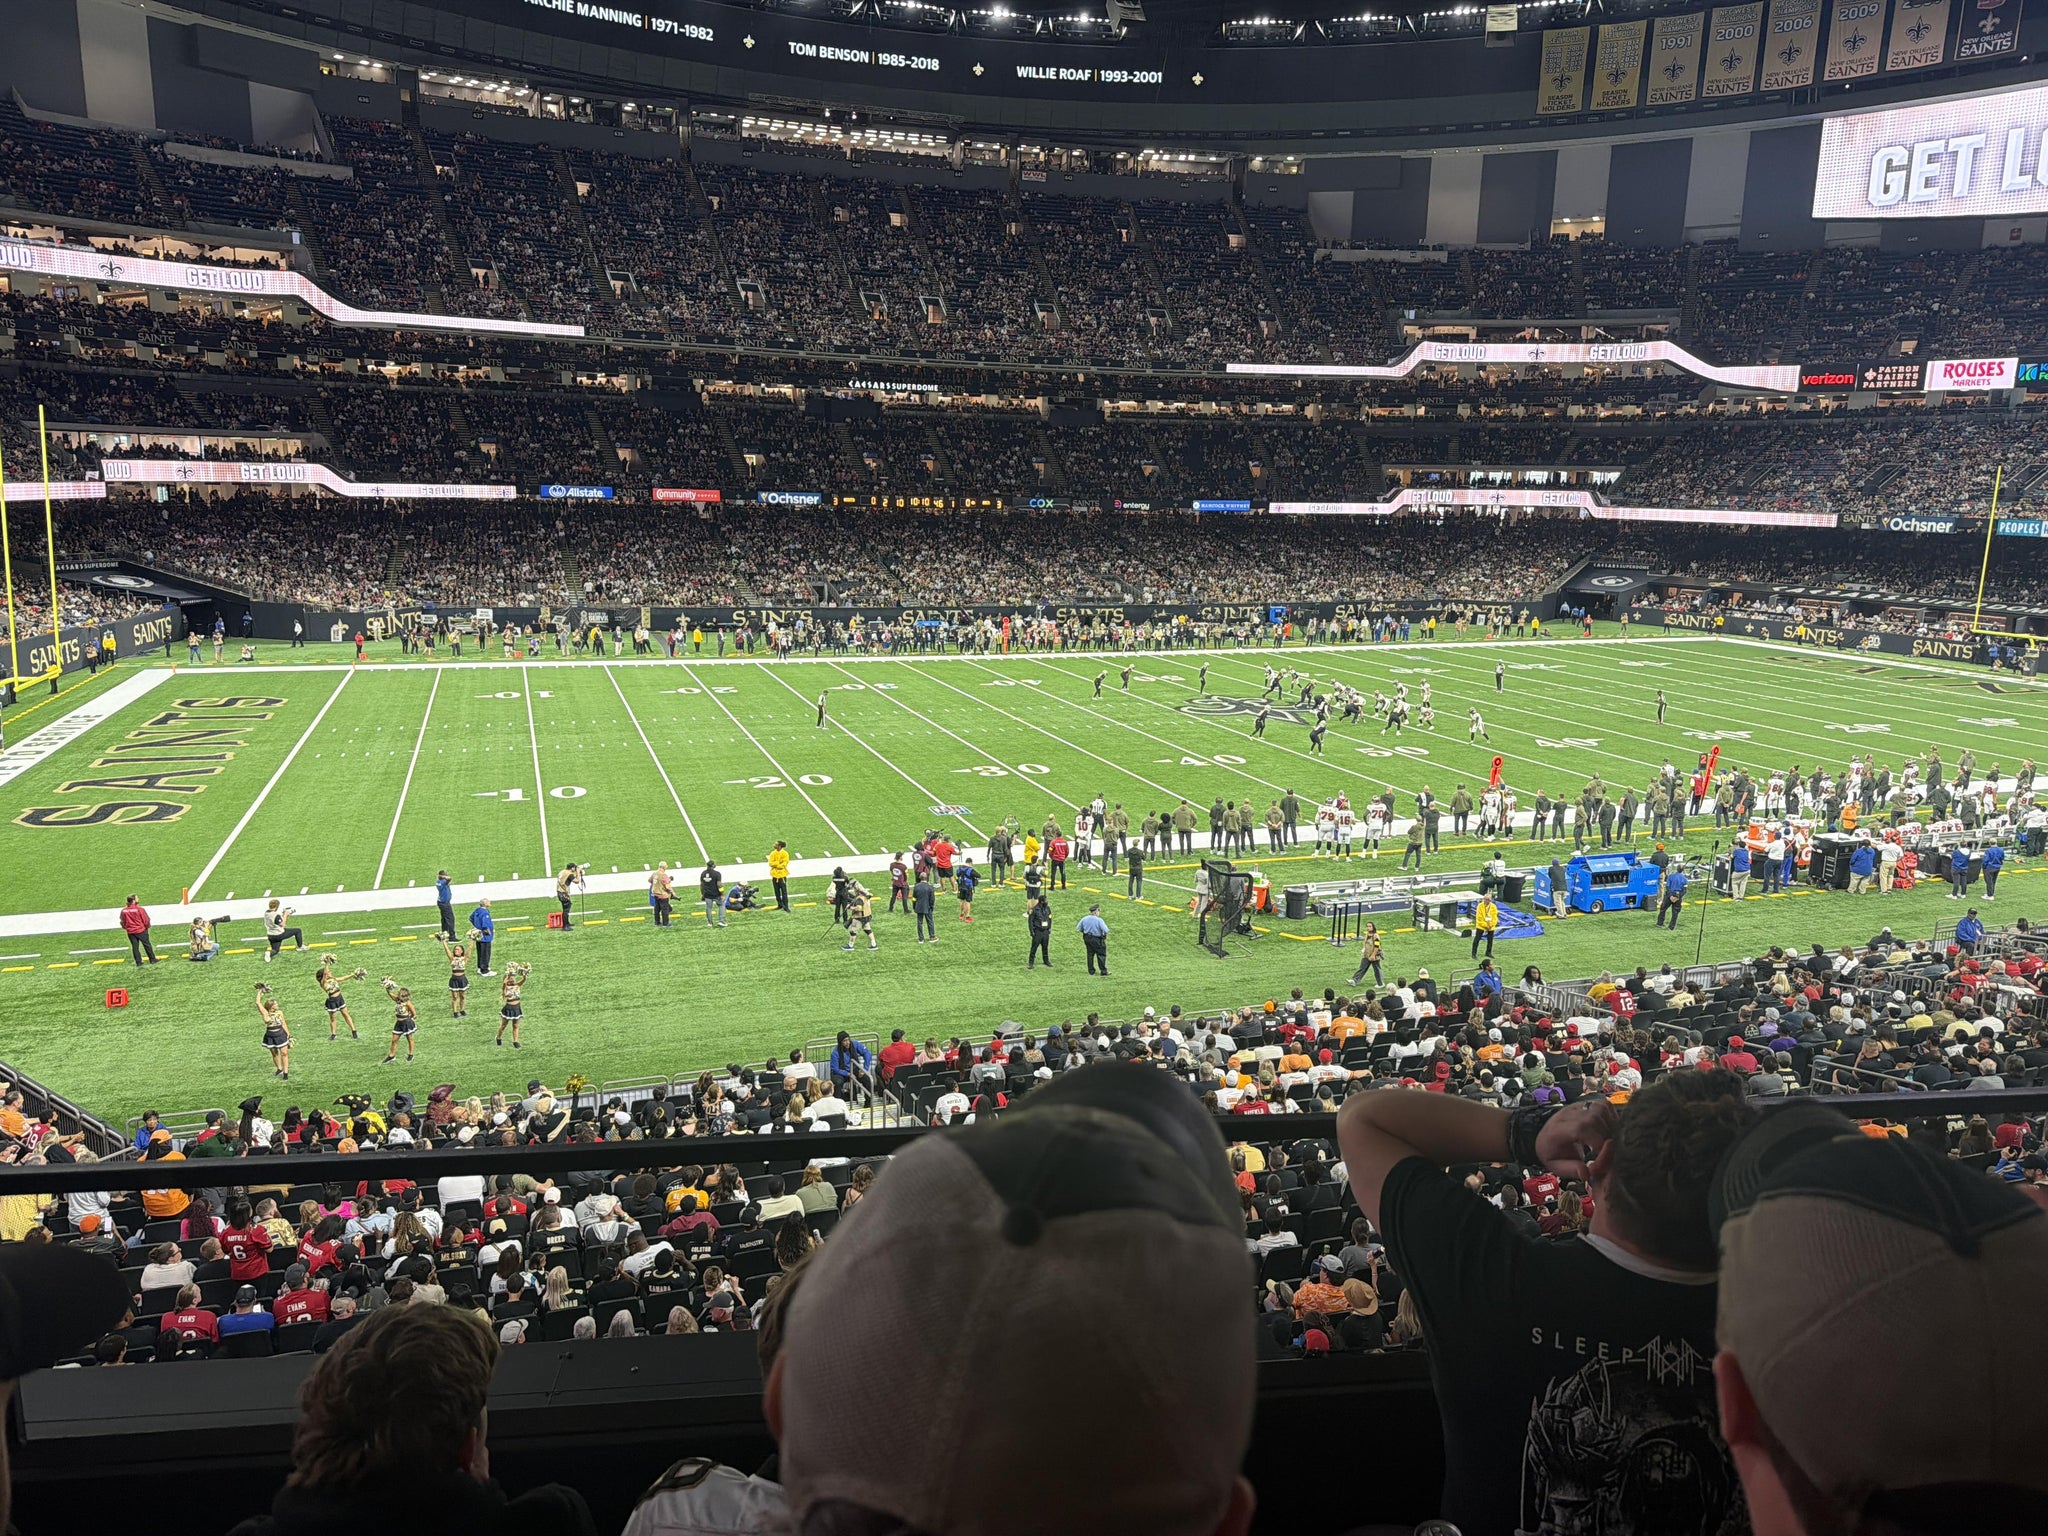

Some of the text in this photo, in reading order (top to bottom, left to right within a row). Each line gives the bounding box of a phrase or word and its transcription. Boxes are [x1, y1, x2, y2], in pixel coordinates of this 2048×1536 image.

[1838, 3, 1879, 21] 2009
[525, 0, 714, 41] CHIE MANNING 1971-1982
[1774, 16, 1813, 33] 2006
[1715, 25, 1754, 41] 2000
[1981, 31, 2013, 42] ORLEANS
[1661, 35, 1692, 50] 1991
[1960, 38, 2011, 56] SAINTS
[788, 42, 940, 71] TOM BENSON 1985-2018
[1890, 51, 1939, 68] SAINTS
[1016, 66, 1162, 83] WILLIE ROAF 1993-2001
[1828, 62, 1874, 78] SAINTS
[1764, 73, 1809, 88] SAINTS
[1706, 81, 1750, 95] SAINTS
[1650, 89, 1692, 103] SAINTS
[1596, 99, 1631, 108] HOLDERS
[1868, 127, 2048, 207] GET L
[186, 268, 263, 294] GET LOUD
[58, 324, 94, 336] SAINTS
[589, 329, 623, 338] SAINTS
[138, 332, 175, 344] SAINTS
[664, 334, 697, 342] SAINTS
[734, 338, 767, 347] SAINTS
[221, 340, 257, 351] SAINTS
[804, 342, 836, 351] SAINTS
[870, 347, 901, 355] SAINTS
[306, 347, 343, 357] SAINTS
[388, 353, 423, 362] SAINTS
[936, 352, 966, 360] SAINTS
[1434, 346, 1486, 361] GET LOUD
[1589, 346, 1646, 360] GET LOUD
[469, 357, 502, 366] SAINTS
[999, 354, 1029, 363] SAINTS
[1063, 358, 1092, 366] SAINTS
[543, 361, 576, 371] SAINTS
[618, 366, 649, 375] SAINTS
[1124, 361, 1152, 369] SAINTS
[1186, 363, 1214, 371] SAINTS
[1879, 365, 1919, 374] PATRON
[1943, 361, 2006, 379] ROUSES
[688, 370, 718, 379] SAINTS
[1802, 372, 1854, 385] verizon
[1878, 373, 1918, 381] SAINTS
[1863, 380, 1918, 388] PARTNERS
[1952, 379, 1992, 388] MARKETS
[892, 384, 939, 396] SUPERDOME
[241, 464, 305, 481] GET LOUD
[616, 490, 649, 499] SAINTS
[769, 492, 820, 504] Ochsner
[1411, 491, 1453, 503] GET LOUD
[1543, 493, 1562, 505] GET
[833, 497, 839, 506] 3
[871, 496, 877, 505] 0
[882, 499, 888, 507] 2
[896, 499, 904, 507] 10
[997, 500, 1002, 509] 3
[1029, 498, 1054, 509] COX
[1122, 501, 1150, 511] entergy
[1843, 513, 1877, 524] SAINTS
[1889, 517, 1952, 533] Ochsner
[1999, 521, 2039, 534] PEOPLES
[56, 562, 119, 571] AESARS SUPERDOME
[12, 695, 289, 828] SAINTS
[971, 765, 1051, 777] 30
[758, 773, 834, 788] 20
[500, 786, 587, 801] 10
[1372, 809, 1384, 819] 70
[1077, 820, 1088, 832] 10
[111, 989, 122, 1006] G
[1621, 998, 1634, 1011] 12
[546, 1236, 566, 1245] BREES
[233, 1245, 246, 1260] 6
[287, 1302, 307, 1312] EVANS
[178, 1315, 197, 1323] EVANS
[1531, 1327, 1637, 1364] SLEEP
